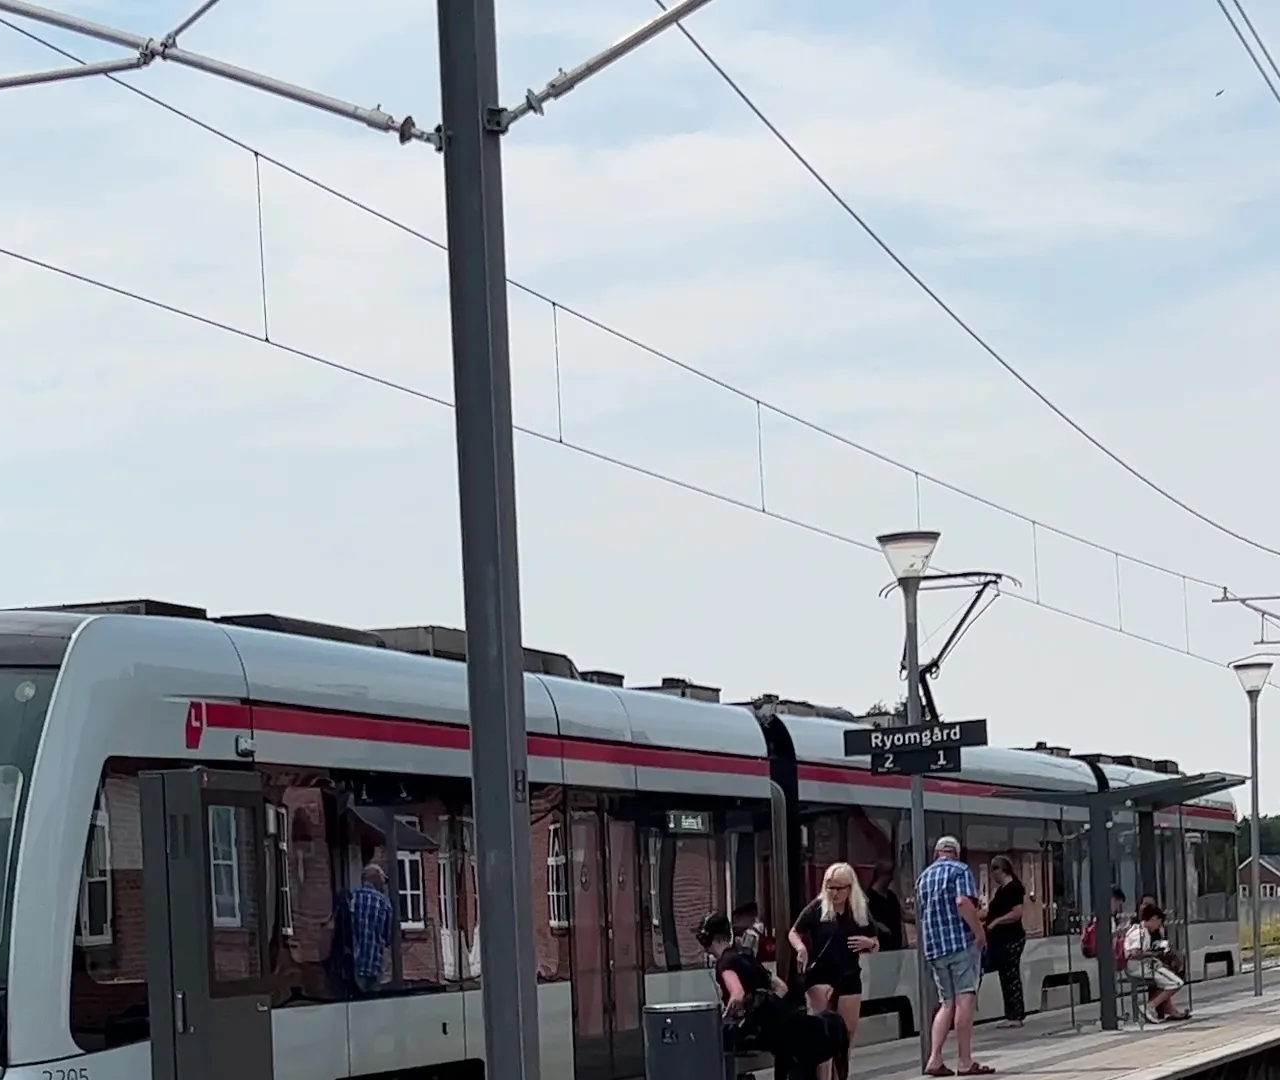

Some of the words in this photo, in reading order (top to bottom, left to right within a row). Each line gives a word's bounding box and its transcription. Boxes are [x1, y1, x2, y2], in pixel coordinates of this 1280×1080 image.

[871, 725, 960, 750] Ryomgård
[883, 754, 894, 768] 2
[937, 750, 947, 765] 1
